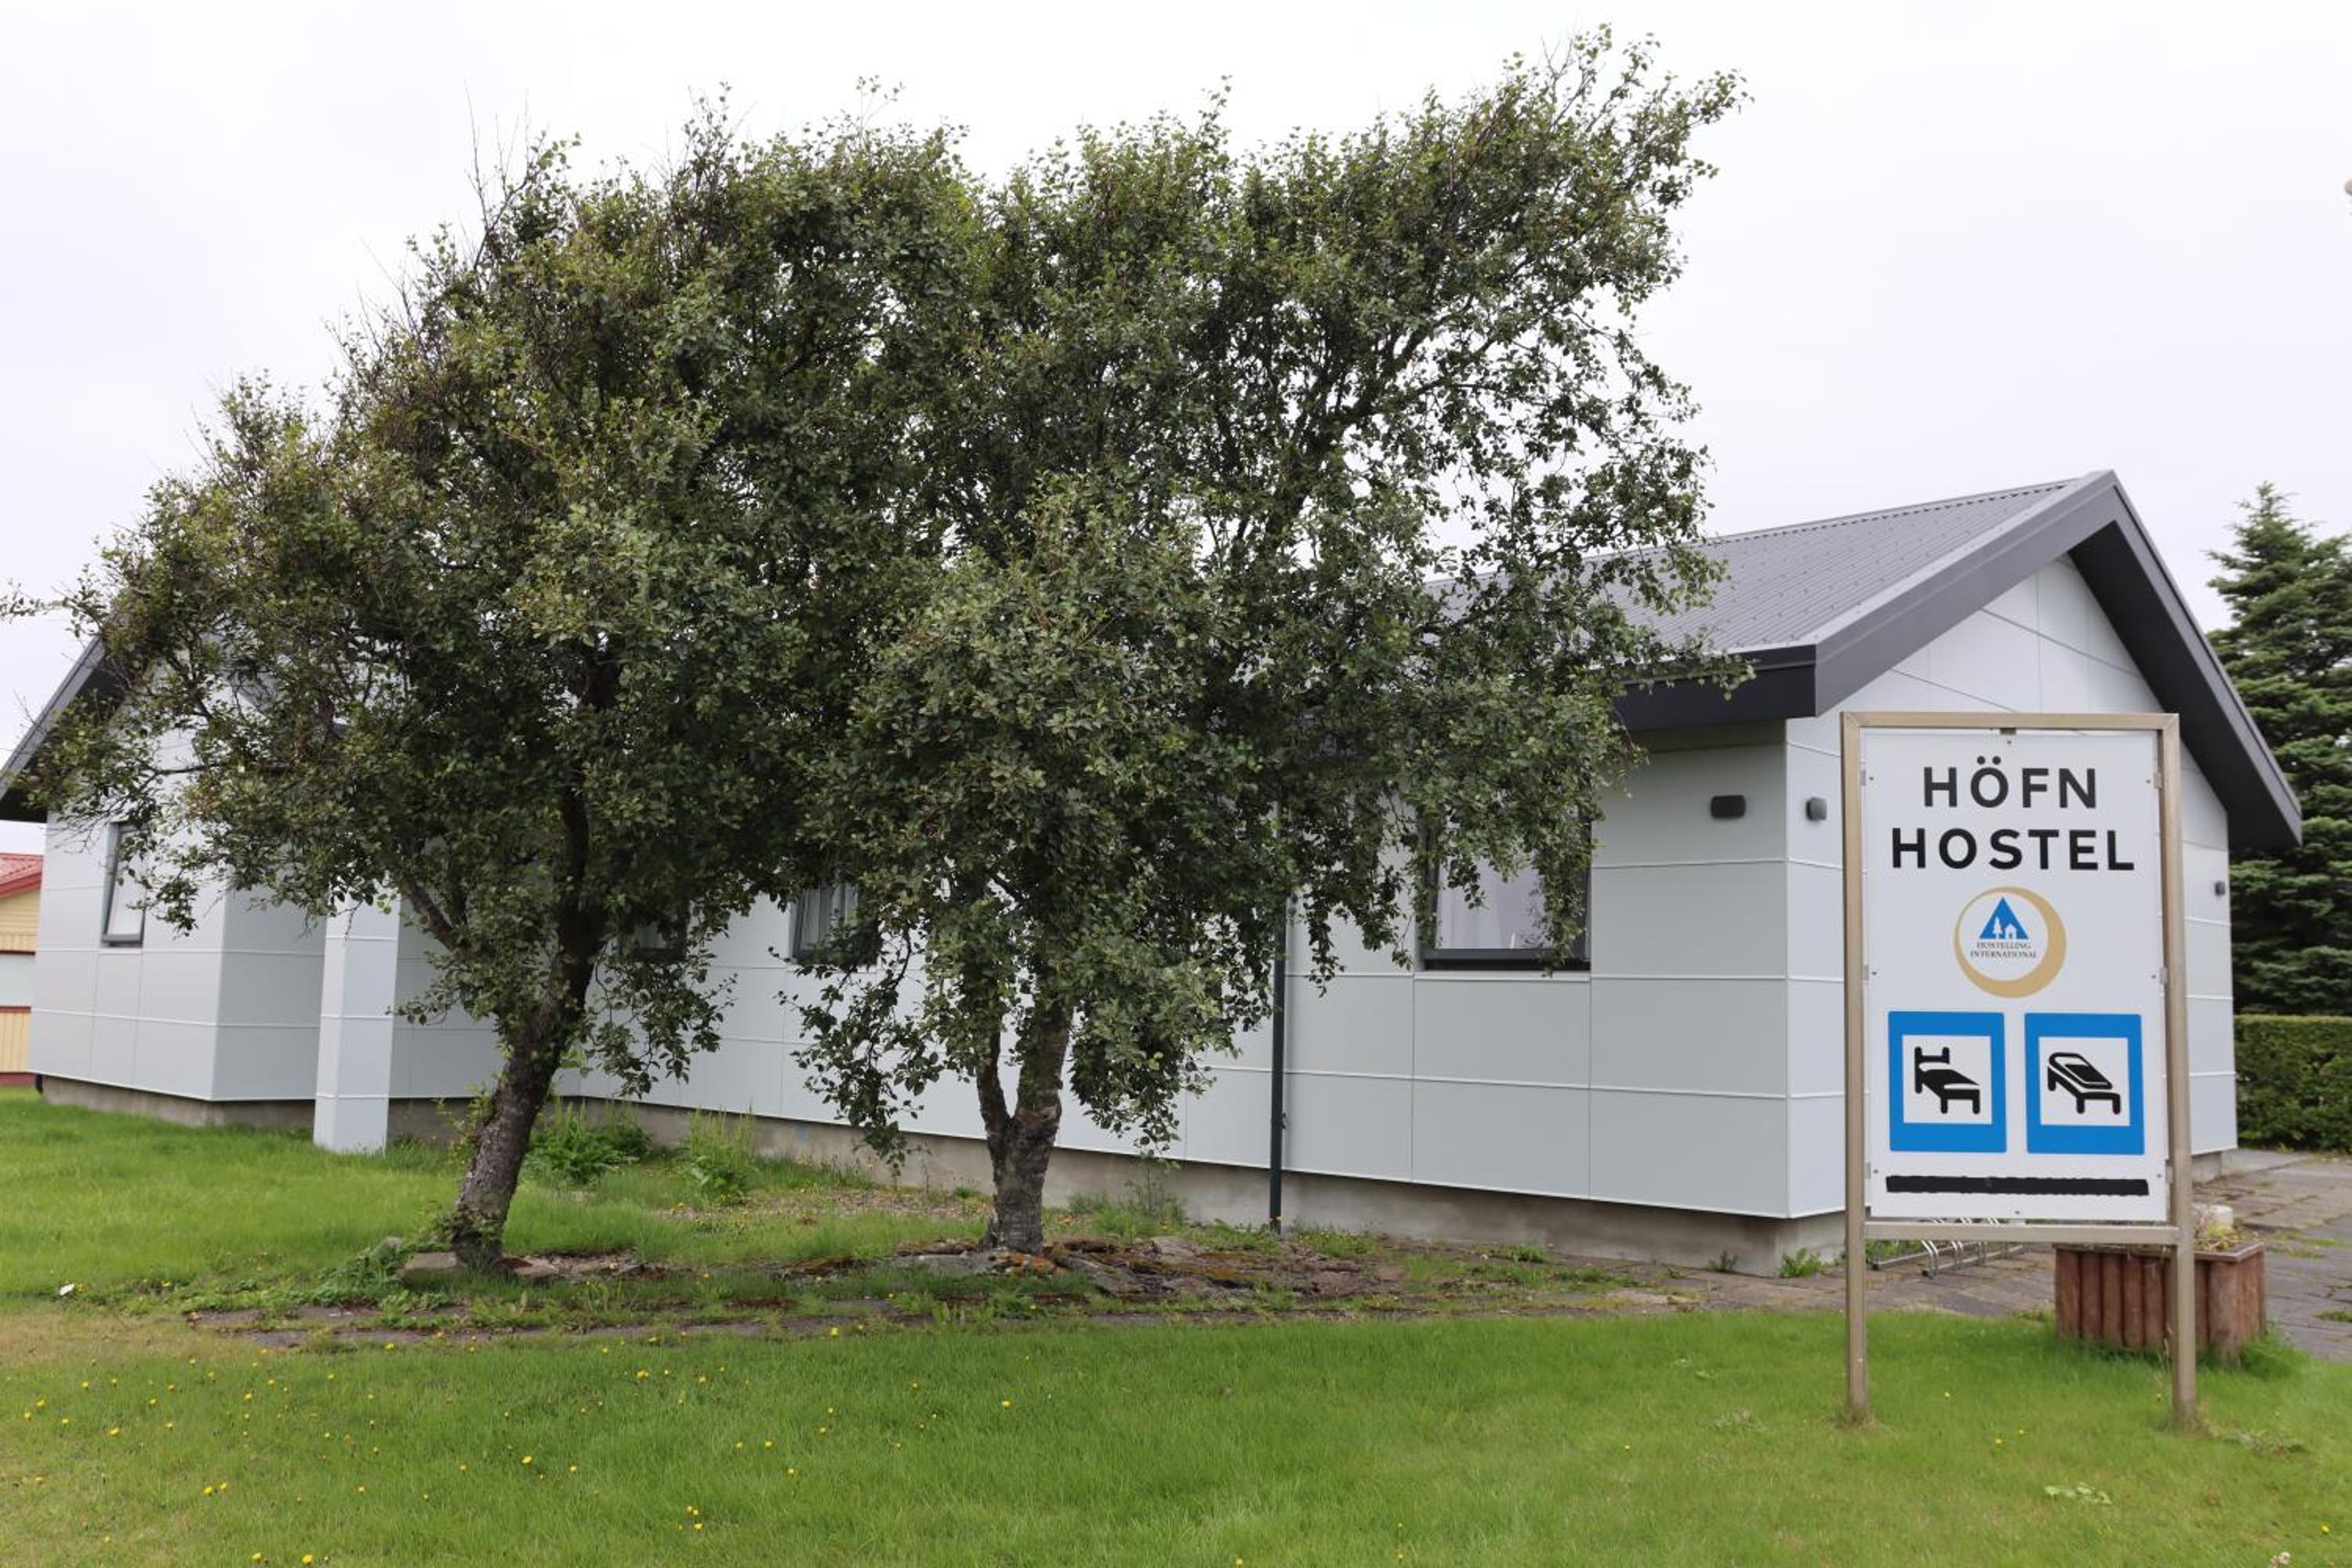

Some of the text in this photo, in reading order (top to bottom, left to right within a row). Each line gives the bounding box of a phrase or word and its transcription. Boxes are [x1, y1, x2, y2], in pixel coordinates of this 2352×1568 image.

[1923, 755, 2096, 809] HÖFN
[1892, 827, 2135, 871] HOSTEL
[1970, 950, 2037, 959] INTERNATIONAL
